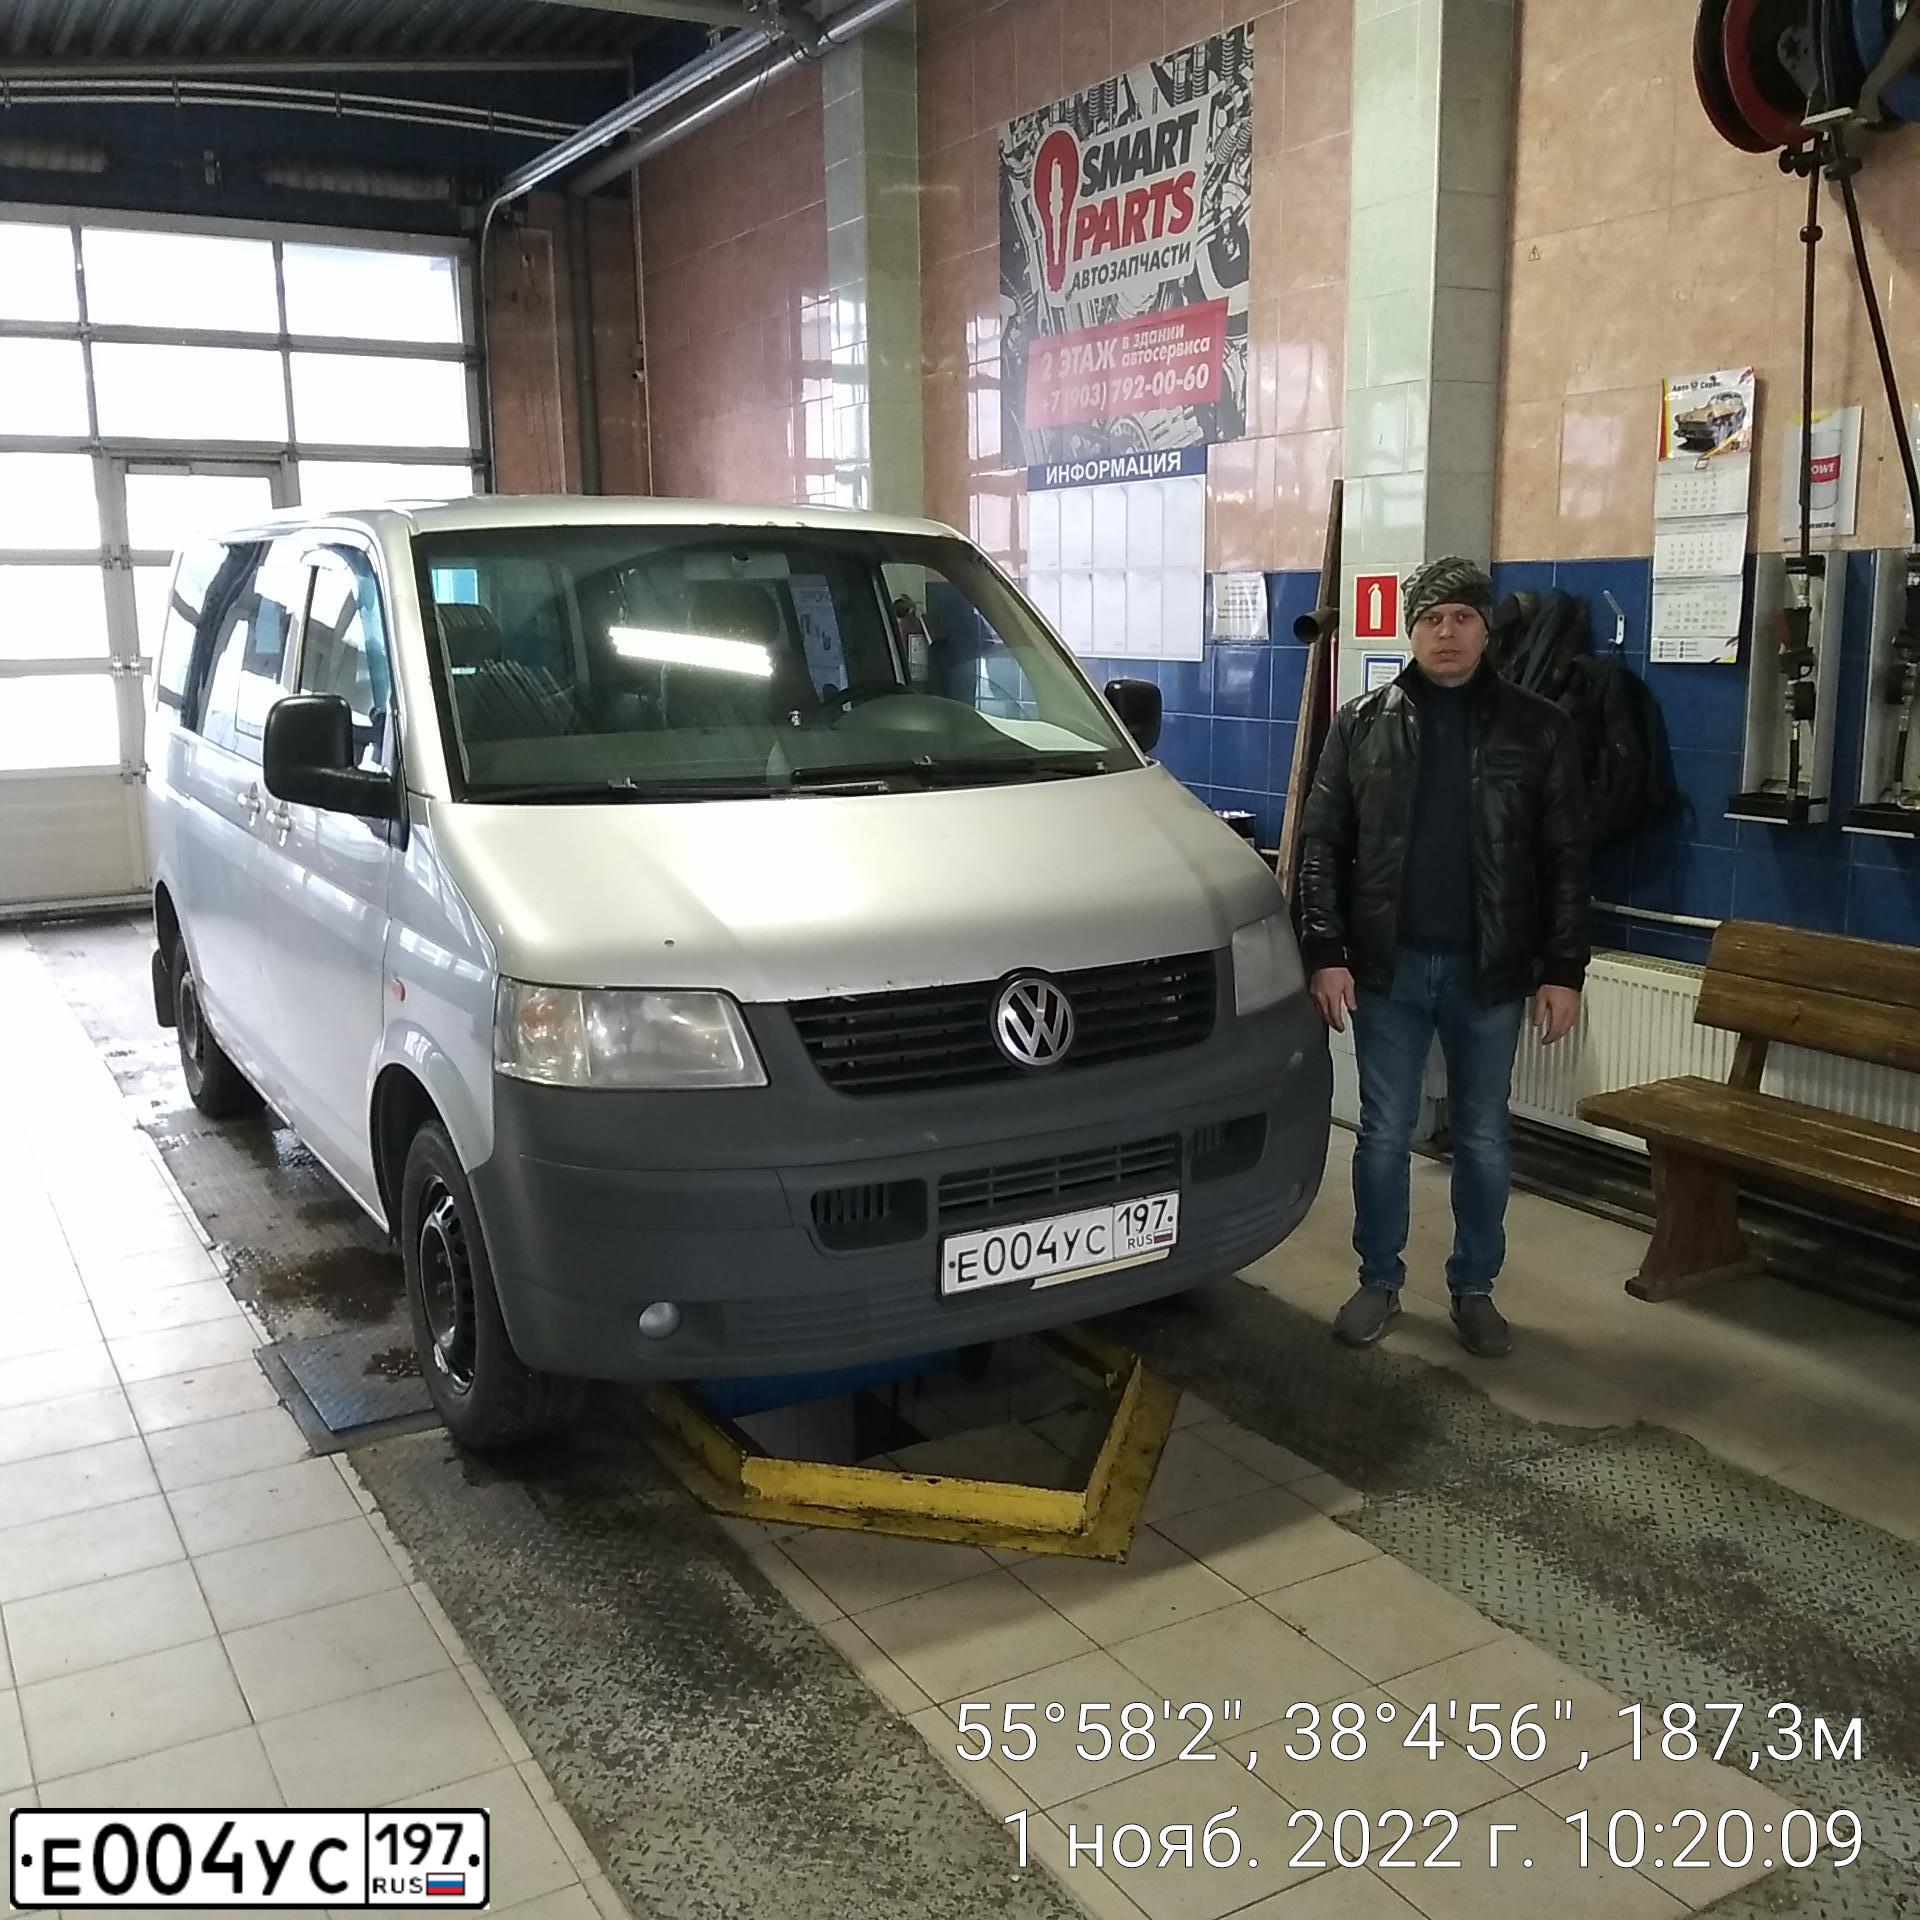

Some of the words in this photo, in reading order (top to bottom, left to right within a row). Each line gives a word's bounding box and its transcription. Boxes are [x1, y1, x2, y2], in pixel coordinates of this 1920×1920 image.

[1080, 108, 1200, 198] SMART
[1073, 170, 1196, 262] PARTS
[1071, 241, 1191, 291] АВТОЗАПЧАСТИ
[1122, 336, 1129, 350] в
[1134, 324, 1185, 349] здании
[1122, 336, 1211, 367] автосервиса
[1041, 351, 1052, 381] 2
[1058, 338, 1117, 379] ЭТАЖ
[1111, 363, 1210, 404] 792-00-60
[1046, 451, 1182, 485] ИНФОРМАЦИЯ
[1811, 462, 1835, 475] OWE
[1117, 1199, 1168, 1236] 197
[1127, 1233, 1153, 1250] RUS
